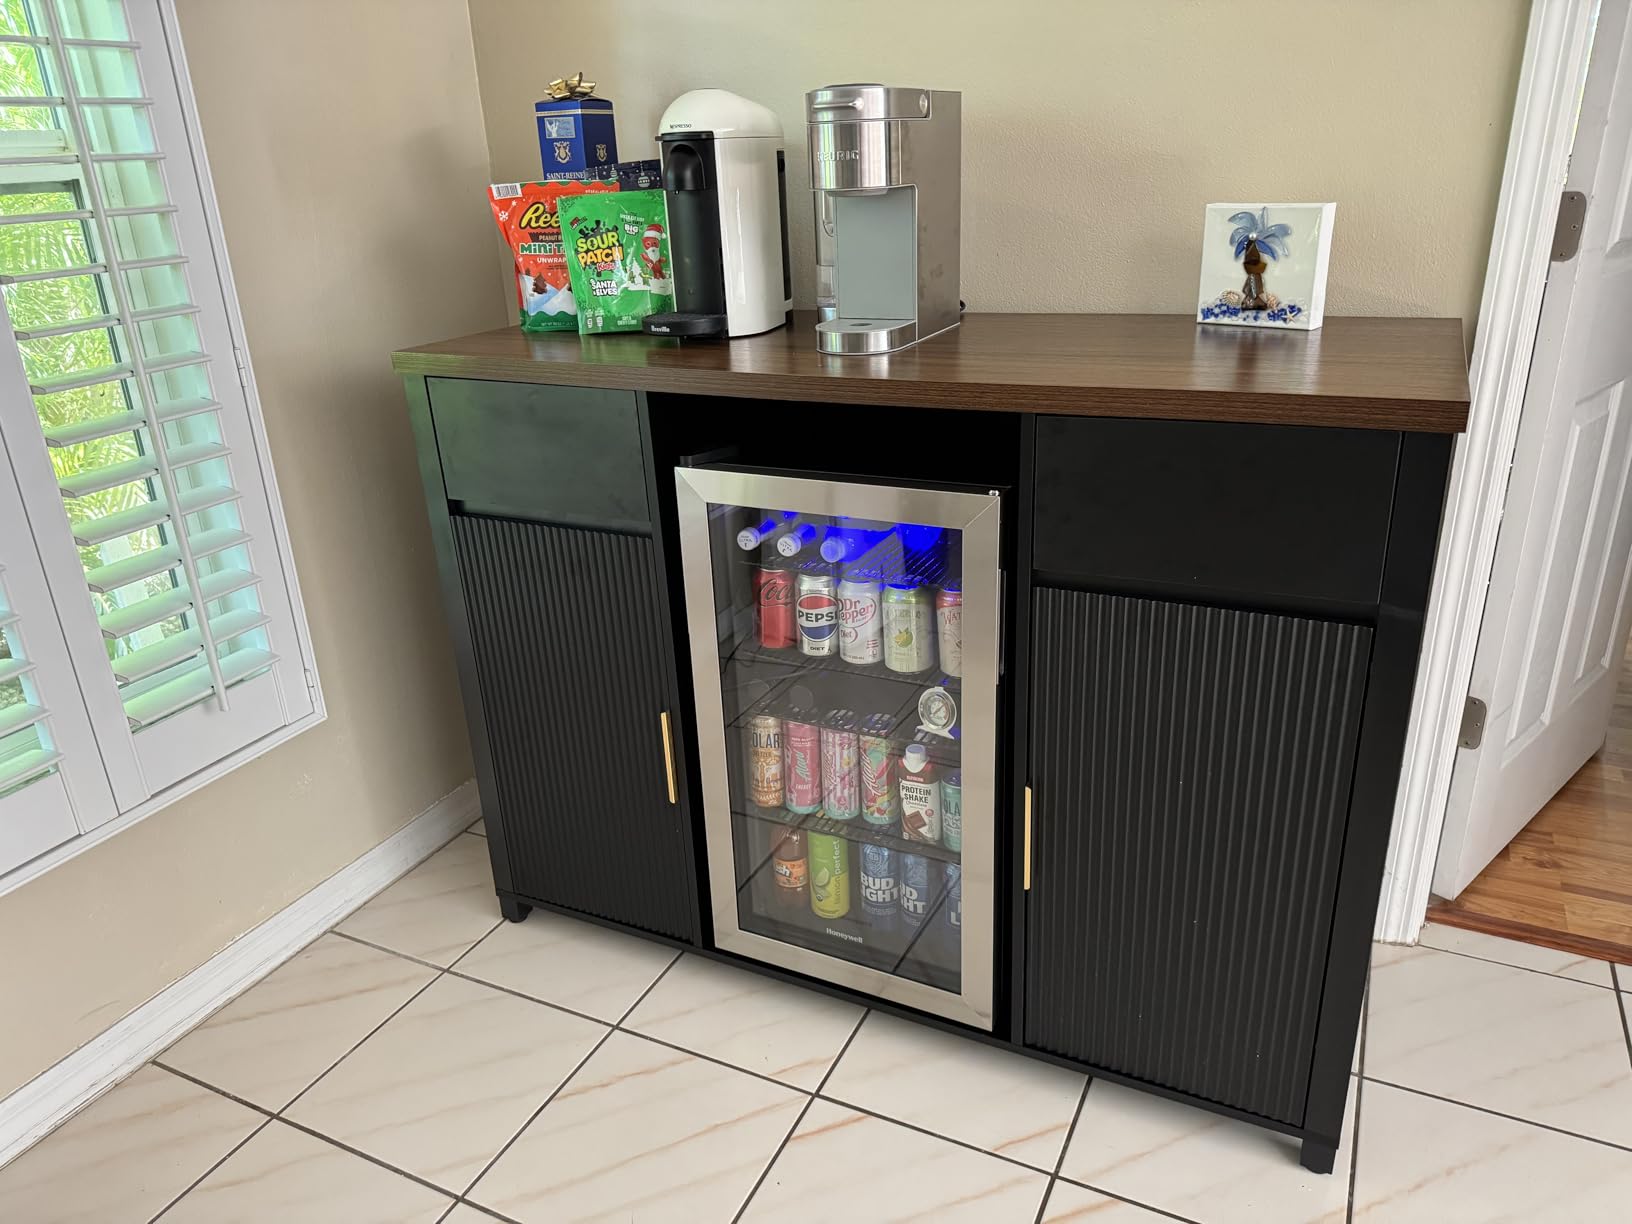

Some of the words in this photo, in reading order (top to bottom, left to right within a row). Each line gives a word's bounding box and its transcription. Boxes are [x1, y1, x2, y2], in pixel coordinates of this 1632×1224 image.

[817, 150, 859, 162] KEURIG
[519, 202, 561, 230] Ree
[624, 224, 639, 233] BIG
[576, 231, 619, 252] SOUR
[577, 246, 624, 269] PATCH
[596, 262, 616, 271] Kids
[591, 280, 617, 289] SANTA
[596, 288, 618, 296] ELVES
[843, 597, 861, 610] Dr
[752, 732, 780, 749] OLAR
[901, 784, 932, 797] PROTEIN
[903, 793, 929, 804] SHAKE
[832, 839, 841, 875] perfect
[860, 871, 894, 890] BUD
[861, 886, 899, 903] IGHT
[826, 927, 863, 944] Honeywell
